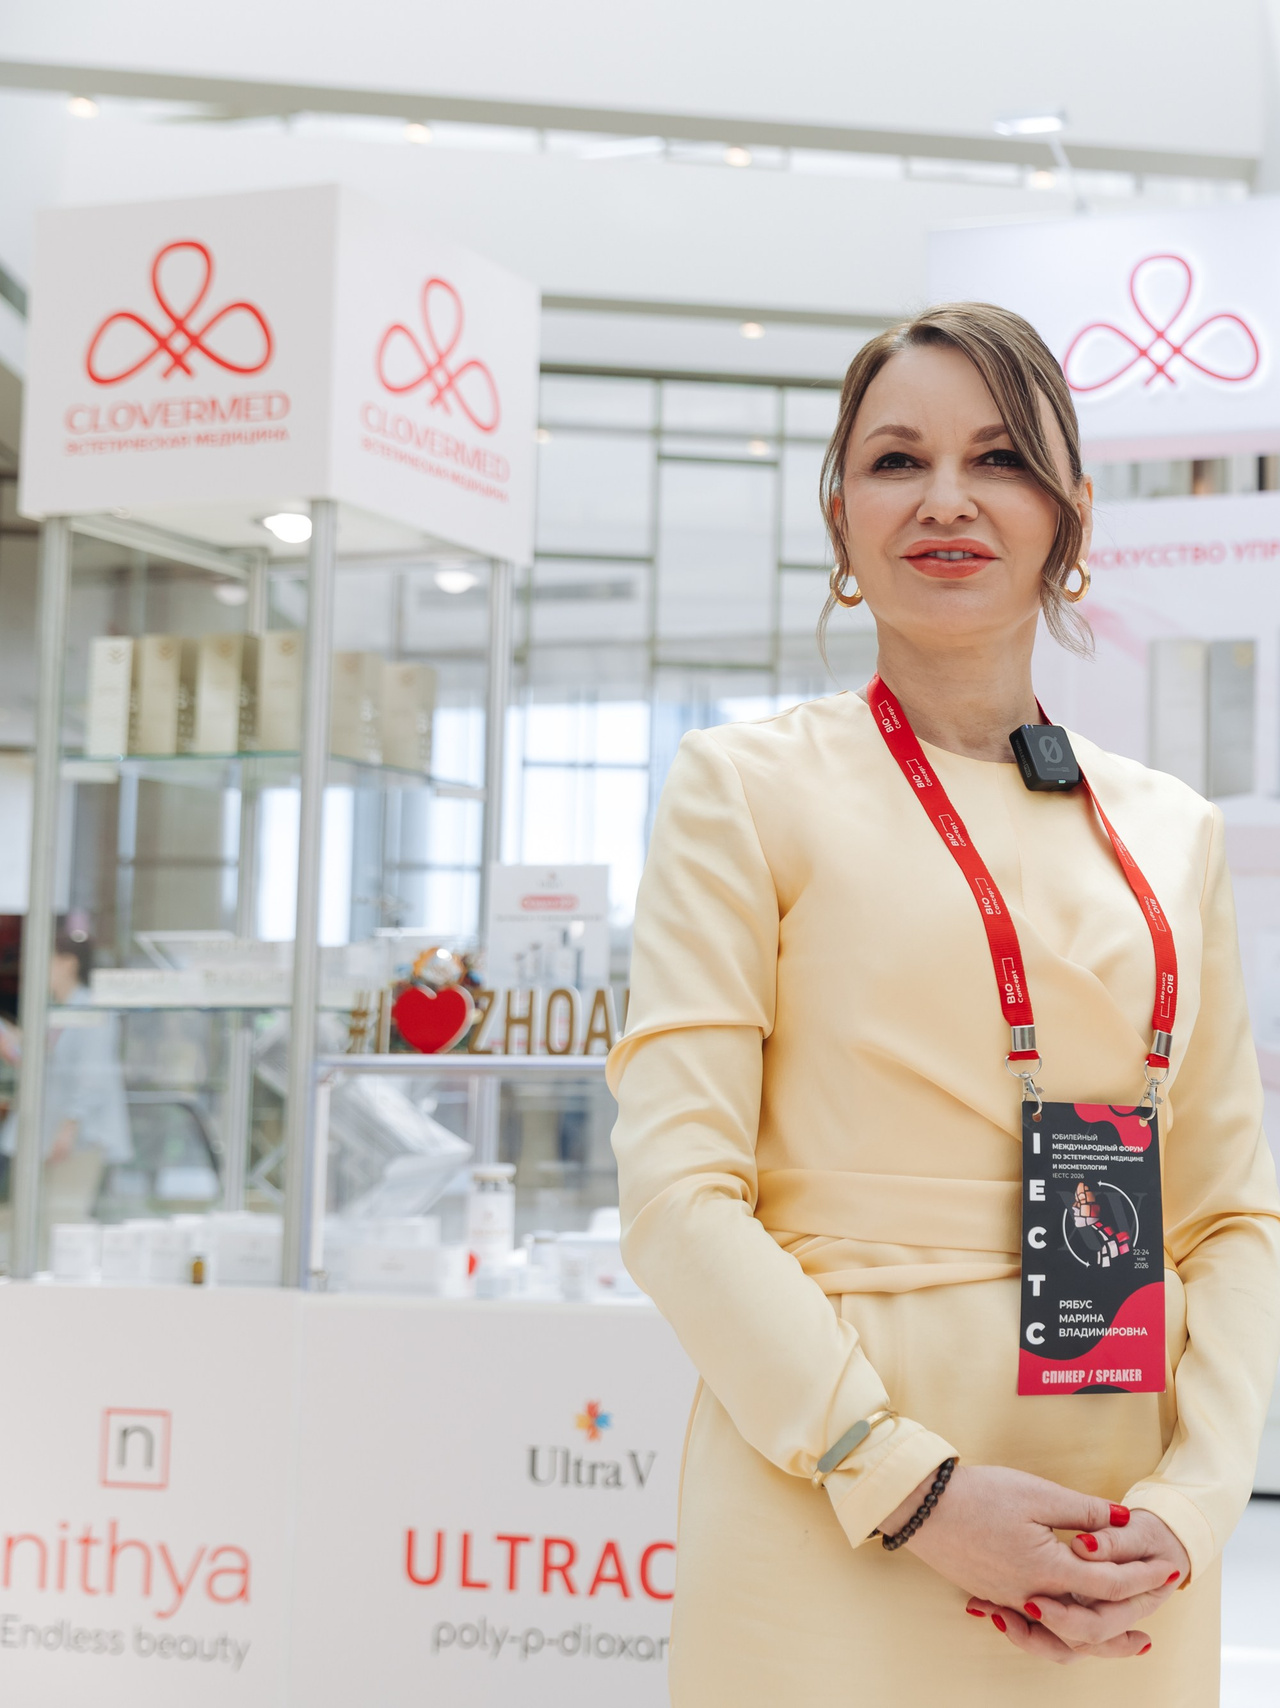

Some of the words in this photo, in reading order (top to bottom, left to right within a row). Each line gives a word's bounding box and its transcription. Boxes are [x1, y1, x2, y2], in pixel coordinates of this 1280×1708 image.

[64, 390, 290, 434] CLOVERMED
[360, 401, 510, 483] CLOVERMED
[882, 718, 894, 733] BIO
[912, 774, 925, 788] BIO
[917, 765, 932, 787] Concept
[946, 832, 959, 847] BIO
[981, 897, 993, 915] BIO
[986, 887, 1001, 914] Concept
[1149, 898, 1160, 914] BIO
[1012, 970, 1023, 1003] Concept
[1166, 974, 1174, 994] BIO
[1004, 983, 1015, 1004] BIO
[1052, 1133, 1098, 1141] ЮБИЛЕЙНЫЙ
[1052, 1143, 1118, 1152] МЕЖДУНАРОДНЫЙ
[1063, 1153, 1109, 1161] ЭСТЕТИЧЕСКОЙ
[1059, 1300, 1093, 1309] РЯБУС
[1059, 1313, 1105, 1323] МАРИНА
[1058, 1327, 1148, 1338] ВЛАДИМИРОВНА
[1042, 1370, 1086, 1384] СПИКЕР
[1095, 1368, 1142, 1383] SPEAKER
[1, 1519, 251, 1620] nithya
[405, 1529, 676, 1601] ULTRAC
[0, 1612, 125, 1656] Endless
[133, 1625, 251, 1672] beauty
